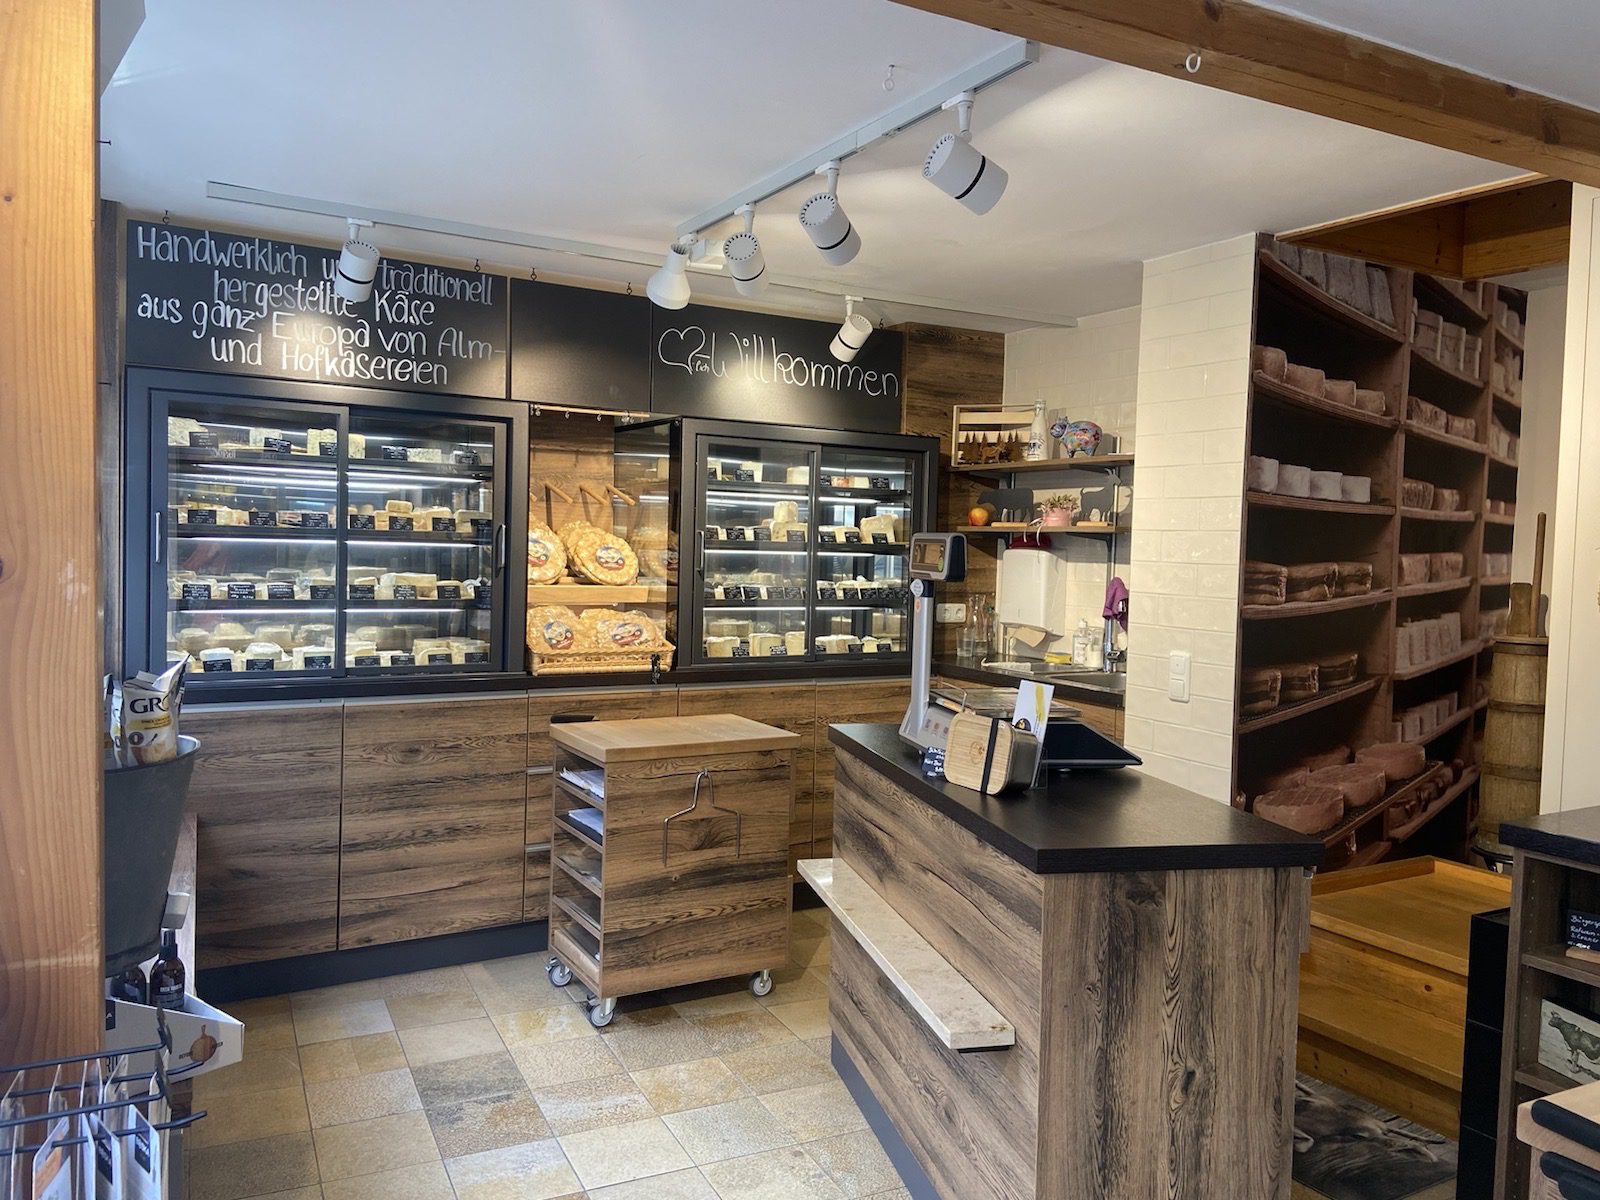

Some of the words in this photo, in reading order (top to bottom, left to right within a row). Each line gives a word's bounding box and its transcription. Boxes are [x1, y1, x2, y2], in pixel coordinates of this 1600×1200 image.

[137, 226, 307, 278] Handwerklich
[378, 259, 493, 306] traditionell
[214, 271, 358, 319] hergestellte
[374, 290, 435, 326] Käse
[137, 293, 181, 324] aus
[192, 300, 256, 338] ganz
[272, 311, 370, 355] Europa
[377, 329, 428, 356] von
[438, 326, 505, 360] Alm-
[211, 334, 262, 367] und
[282, 342, 449, 386] Hofkäsereien
[711, 331, 899, 398] Willkommen
